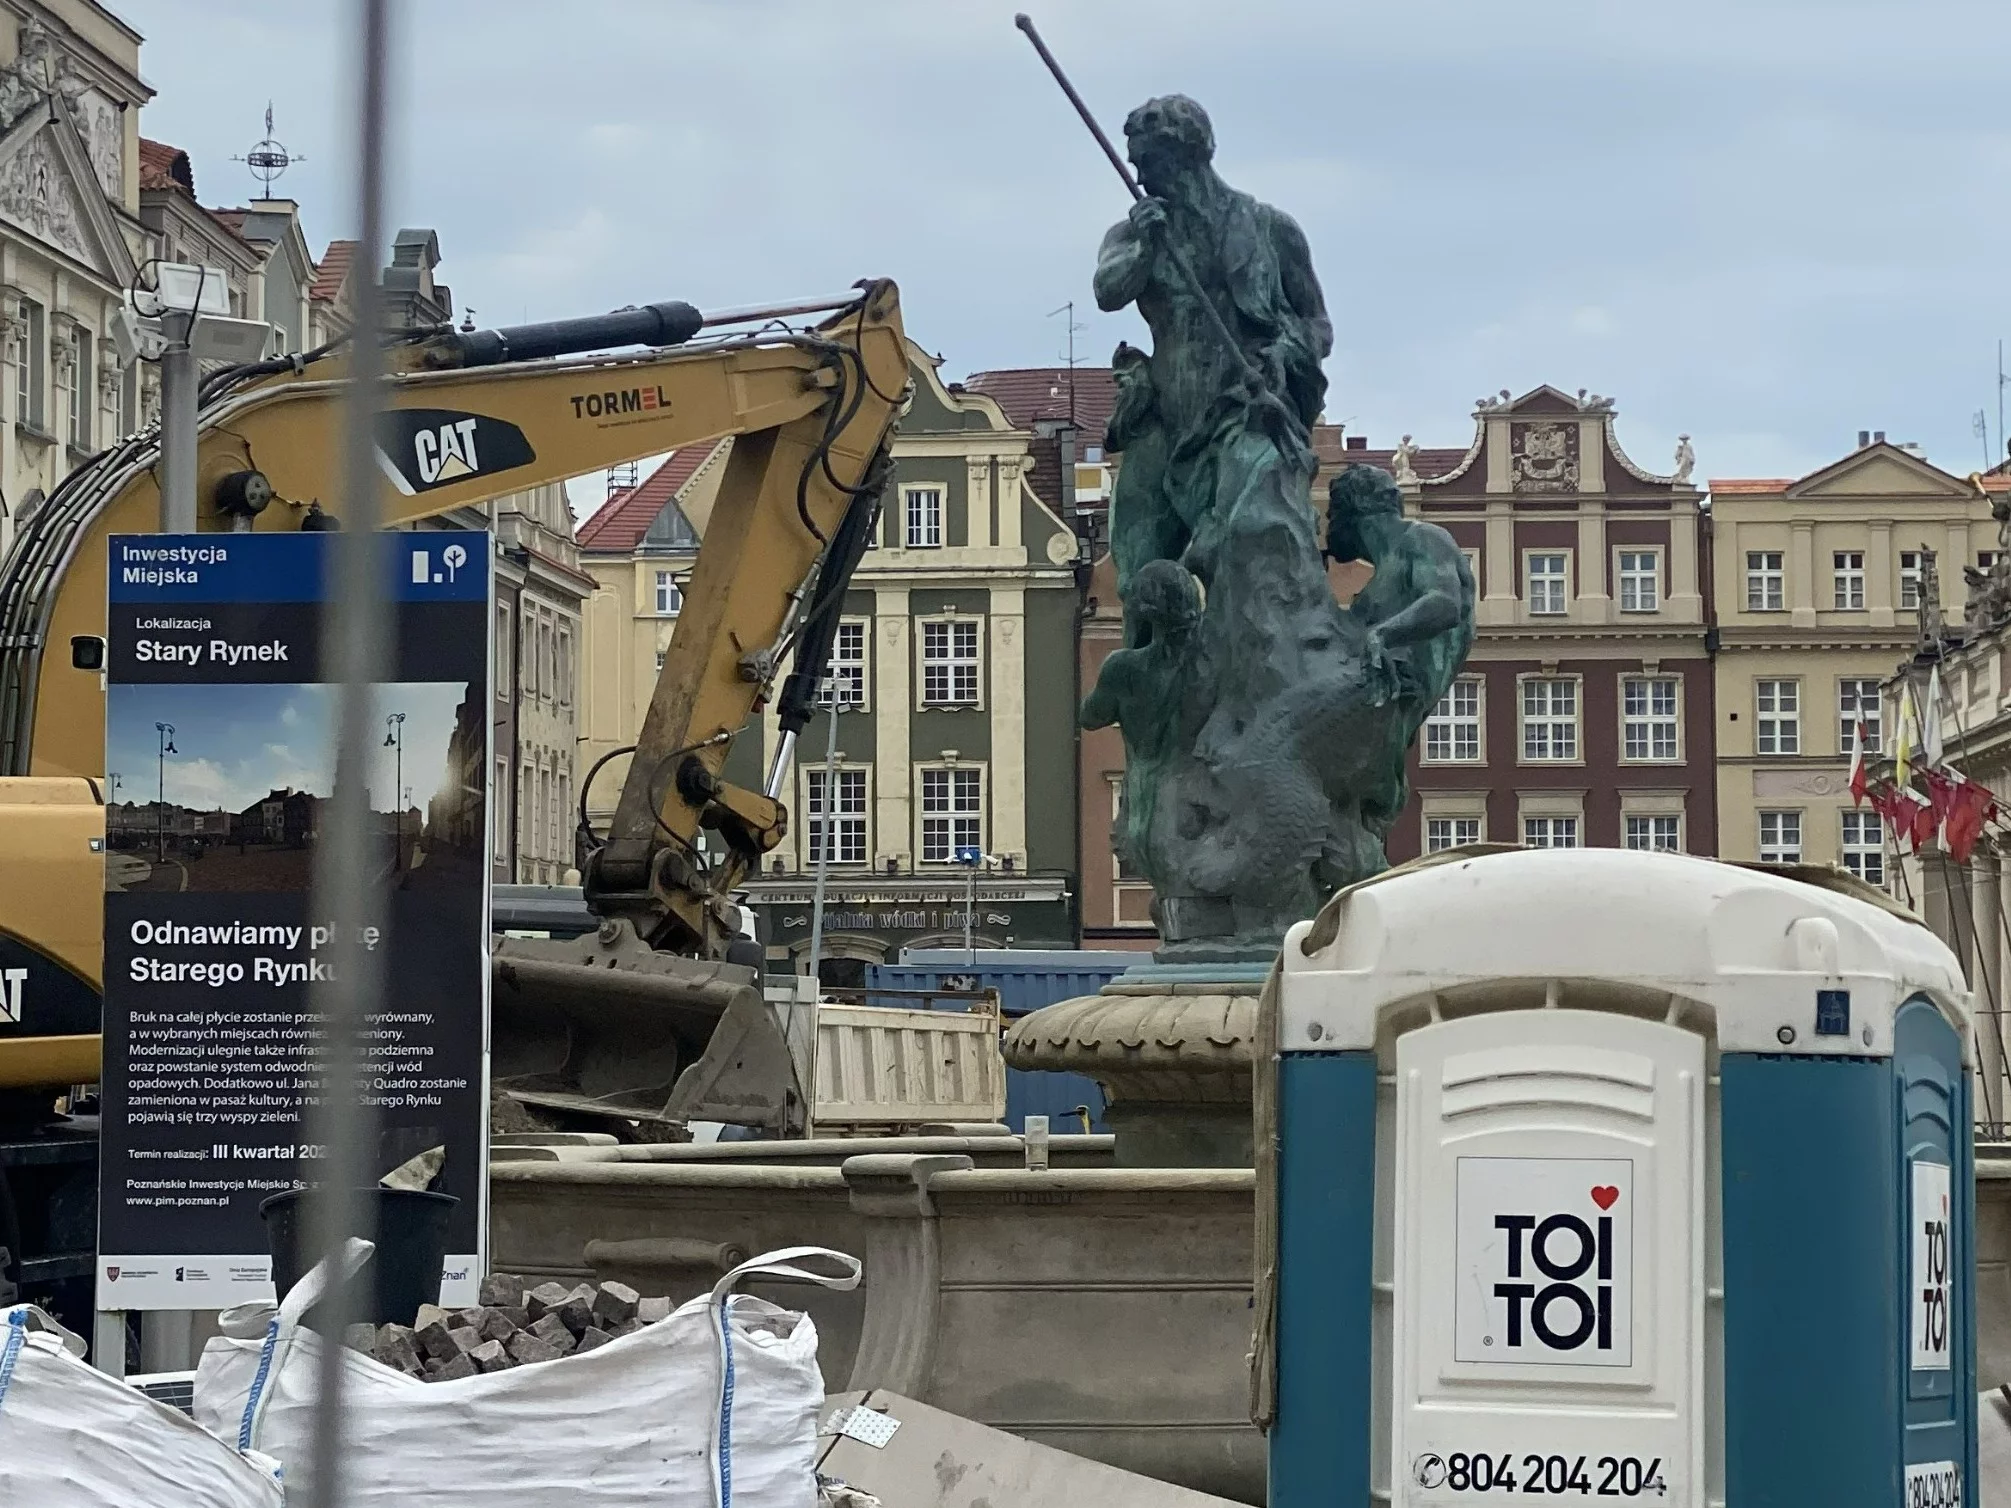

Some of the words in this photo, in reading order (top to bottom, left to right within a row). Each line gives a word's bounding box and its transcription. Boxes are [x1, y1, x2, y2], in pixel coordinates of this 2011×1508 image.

[570, 385, 672, 420] TORMEL
[415, 418, 478, 484] CAT
[123, 545, 228, 566] Inwestycja
[123, 567, 199, 587] Miejska
[136, 617, 212, 631] Lokalizacja
[135, 639, 202, 666] Stary
[210, 640, 288, 666] Rynek
[822, 893, 868, 901] DUKACJI
[822, 911, 874, 930] ijalnia
[880, 909, 926, 928] wódki
[931, 910, 938, 928] i
[130, 920, 303, 950] Odnawiamy
[311, 920, 381, 951] płtę
[129, 957, 244, 987] Starego
[129, 1011, 157, 1022] Bruk
[160, 1013, 174, 1022] na
[176, 1011, 205, 1025] całej
[206, 1011, 241, 1025] płycie
[243, 1011, 292, 1023] zostanie
[364, 1011, 436, 1025] wyrównany,
[129, 1030, 137, 1039] a
[139, 1030, 150, 1039] w
[152, 1028, 218, 1041] wybranych
[220, 1028, 278, 1041] miejscach
[129, 1044, 205, 1058] Modernizacji
[207, 1044, 252, 1058] ulegnie
[254, 1044, 286, 1056] także
[369, 1044, 434, 1058] podziemna
[128, 1063, 155, 1072] oraz
[157, 1061, 219, 1074] powstanie
[220, 1062, 262, 1074] system
[396, 1061, 423, 1072] wód
[128, 1078, 201, 1091] opadowych.
[204, 1078, 274, 1089] Dodatkowo
[276, 1078, 290, 1089] ul.
[291, 1078, 320, 1089] Jana
[373, 1077, 418, 1090] Quadro
[420, 1077, 467, 1089] zostanie
[128, 1094, 197, 1105] zamieniona
[200, 1096, 210, 1105] w
[212, 1094, 247, 1107] pasaż
[249, 1094, 292, 1107] kultury,
[295, 1096, 302, 1105] a
[305, 1096, 320, 1105] na
[358, 1094, 404, 1108] Starego
[406, 1094, 442, 1108] Rynku
[128, 1111, 175, 1125] pojawią
[177, 1111, 194, 1125] się
[196, 1112, 219, 1125] trzy
[220, 1113, 258, 1125] wyspy
[260, 1111, 301, 1121] zieleni.
[128, 1149, 162, 1159] Termin
[164, 1148, 209, 1161] realizacji:
[213, 1144, 228, 1159] III
[233, 1144, 295, 1159] kwartał
[299, 1145, 331, 1159] 202
[126, 1178, 187, 1190] Poznańskie
[189, 1178, 244, 1192] Inwestycje
[247, 1178, 290, 1192] Miejskie
[126, 1195, 230, 1207] www.pim.poznan.pl
[1494, 1213, 1613, 1281] TOI
[1494, 1282, 1613, 1351] TOI
[1448, 1452, 1518, 1492] 804
[1522, 1454, 1592, 1495] 204
[1597, 1456, 1668, 1497] 204
